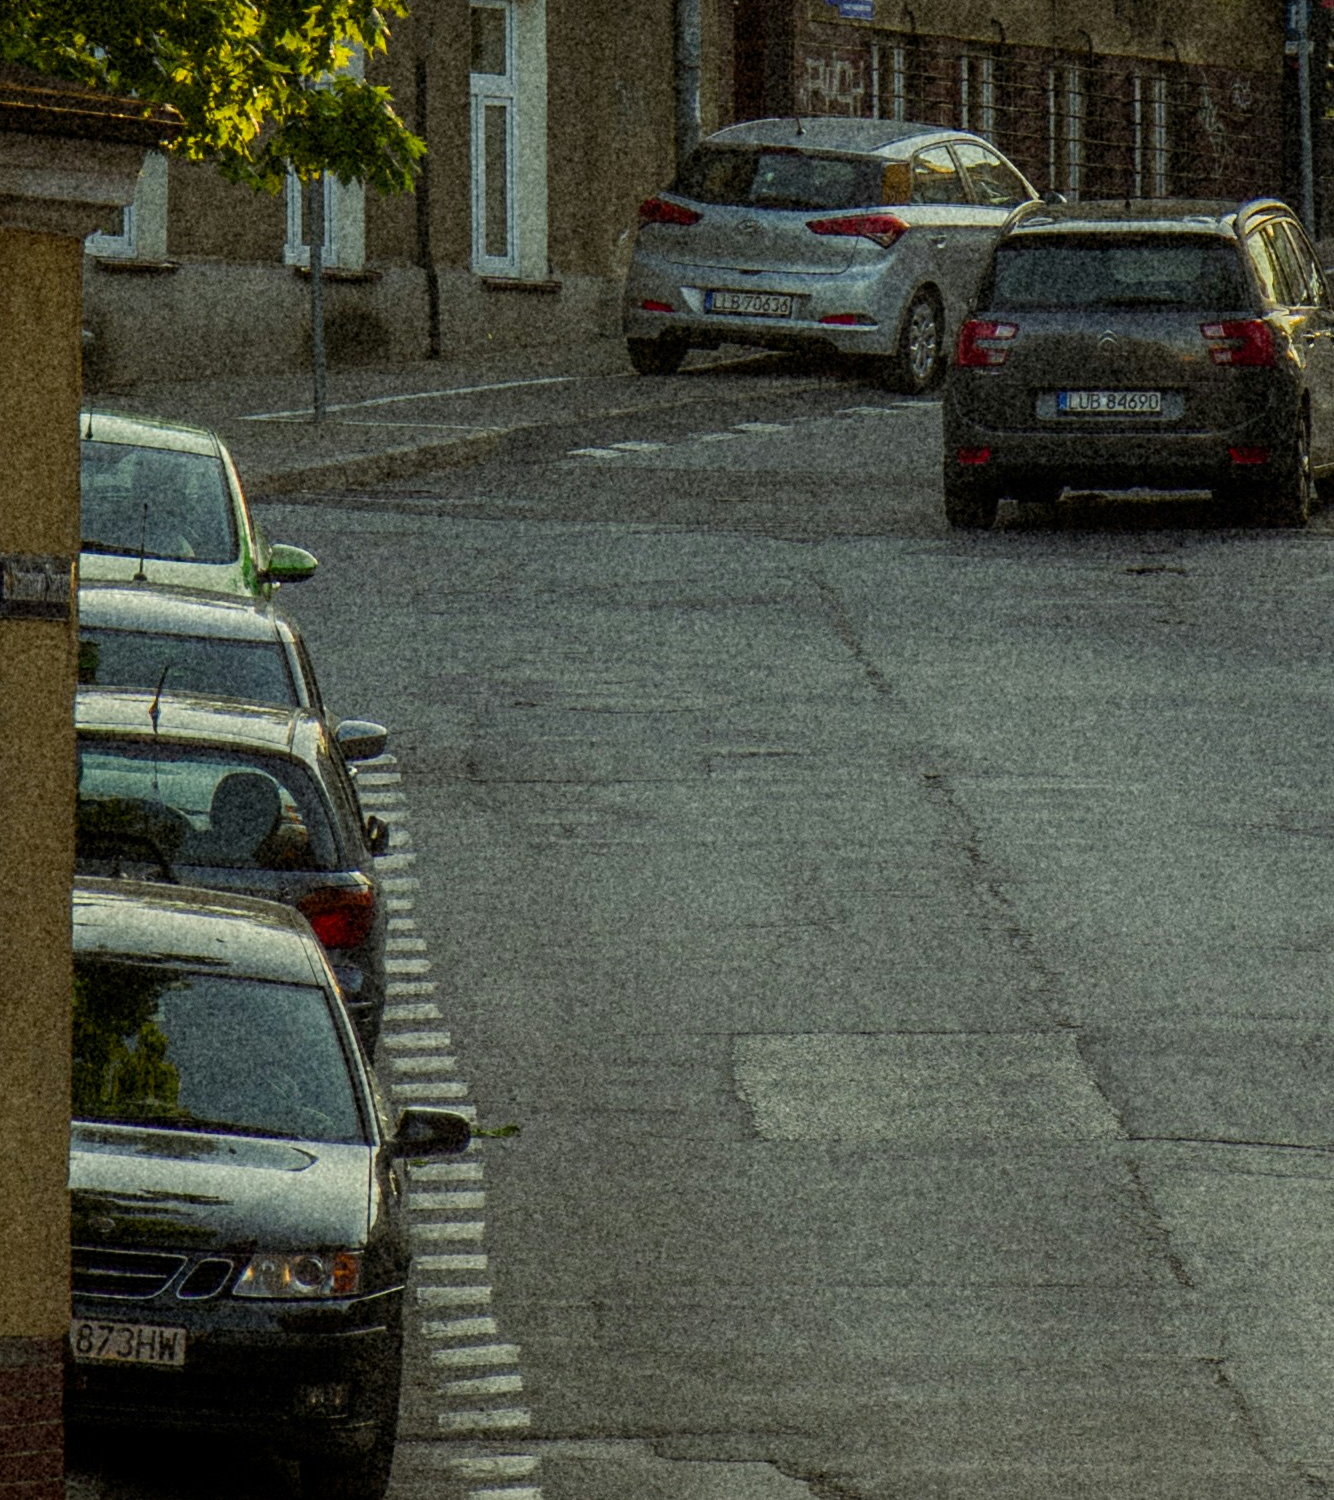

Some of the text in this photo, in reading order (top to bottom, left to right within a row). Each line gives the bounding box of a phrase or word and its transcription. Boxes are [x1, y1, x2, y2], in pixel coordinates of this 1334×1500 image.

[713, 294, 788, 312] LLB 70636
[1069, 393, 1159, 410] LUB 84690
[76, 1324, 178, 1360] 873HW
